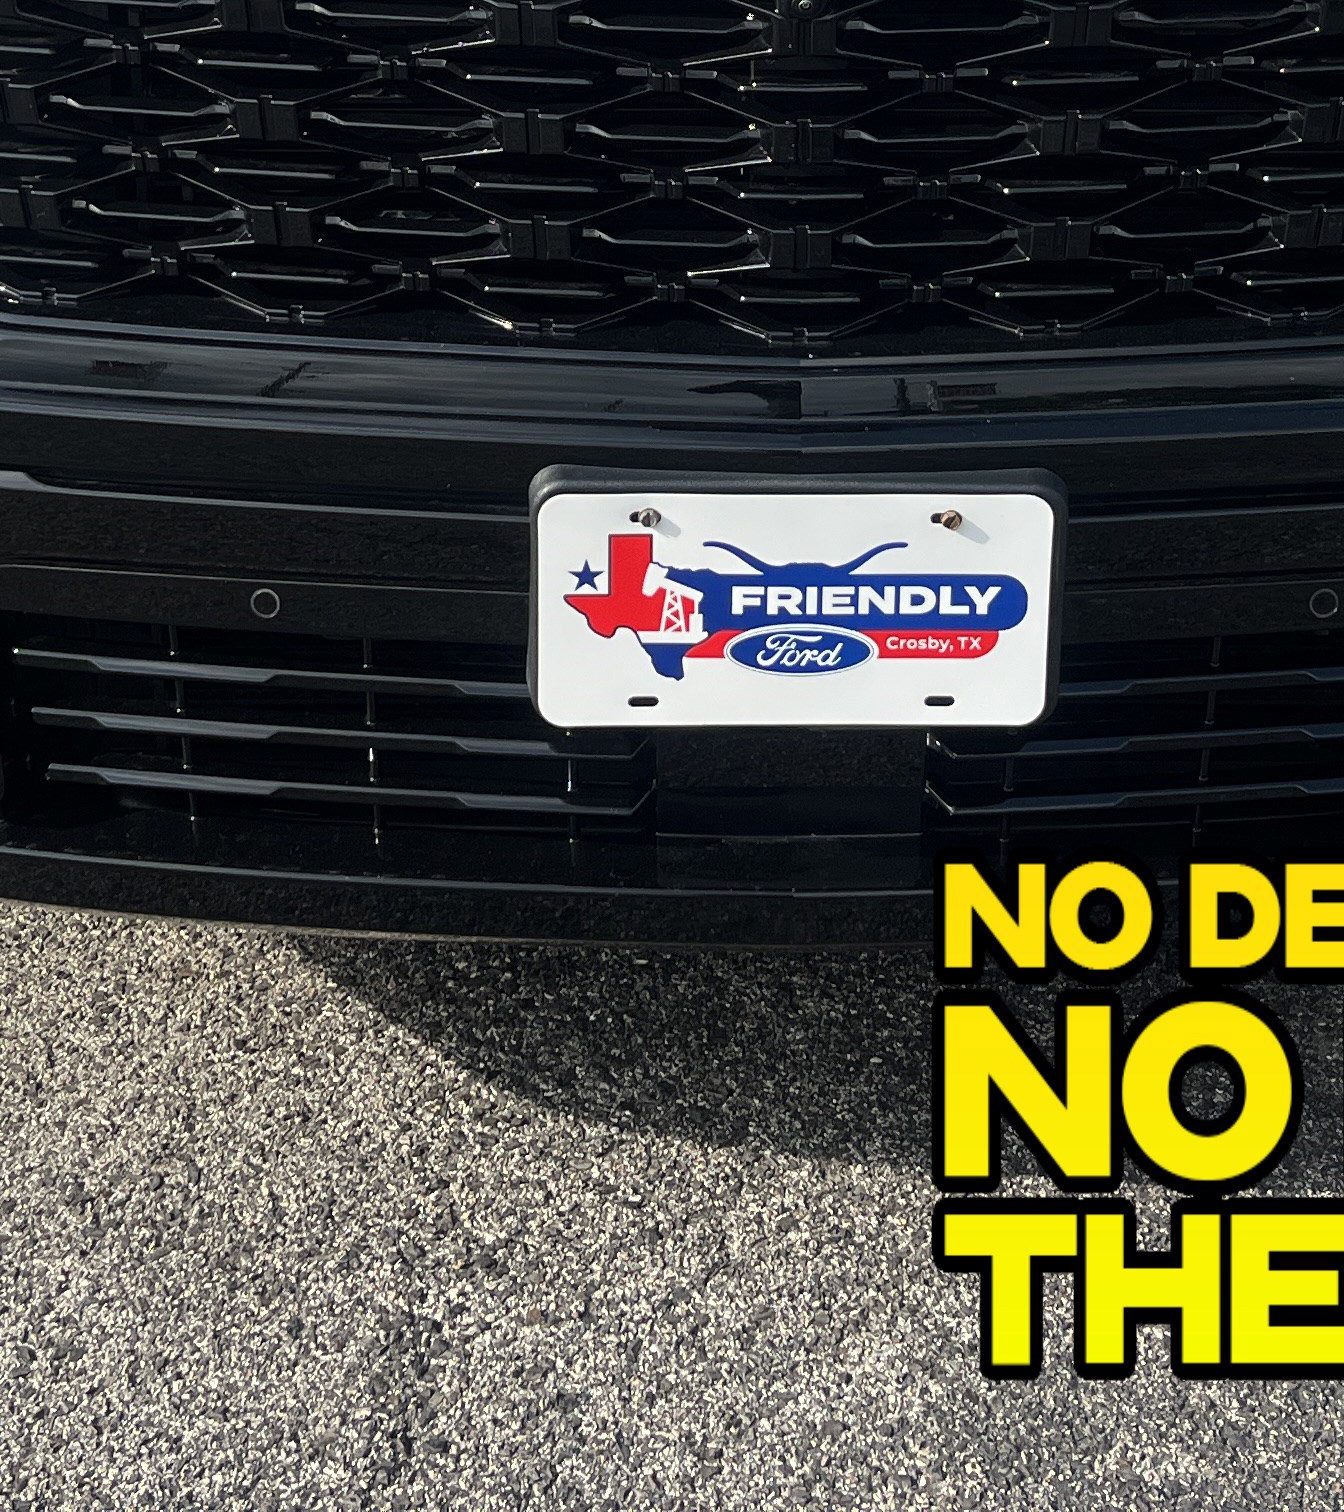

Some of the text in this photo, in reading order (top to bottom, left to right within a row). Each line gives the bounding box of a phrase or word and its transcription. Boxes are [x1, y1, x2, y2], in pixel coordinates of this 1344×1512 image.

[731, 585, 1002, 616] FRIENDLY
[756, 633, 844, 667] Ford
[885, 635, 982, 654] Crosby, TX
